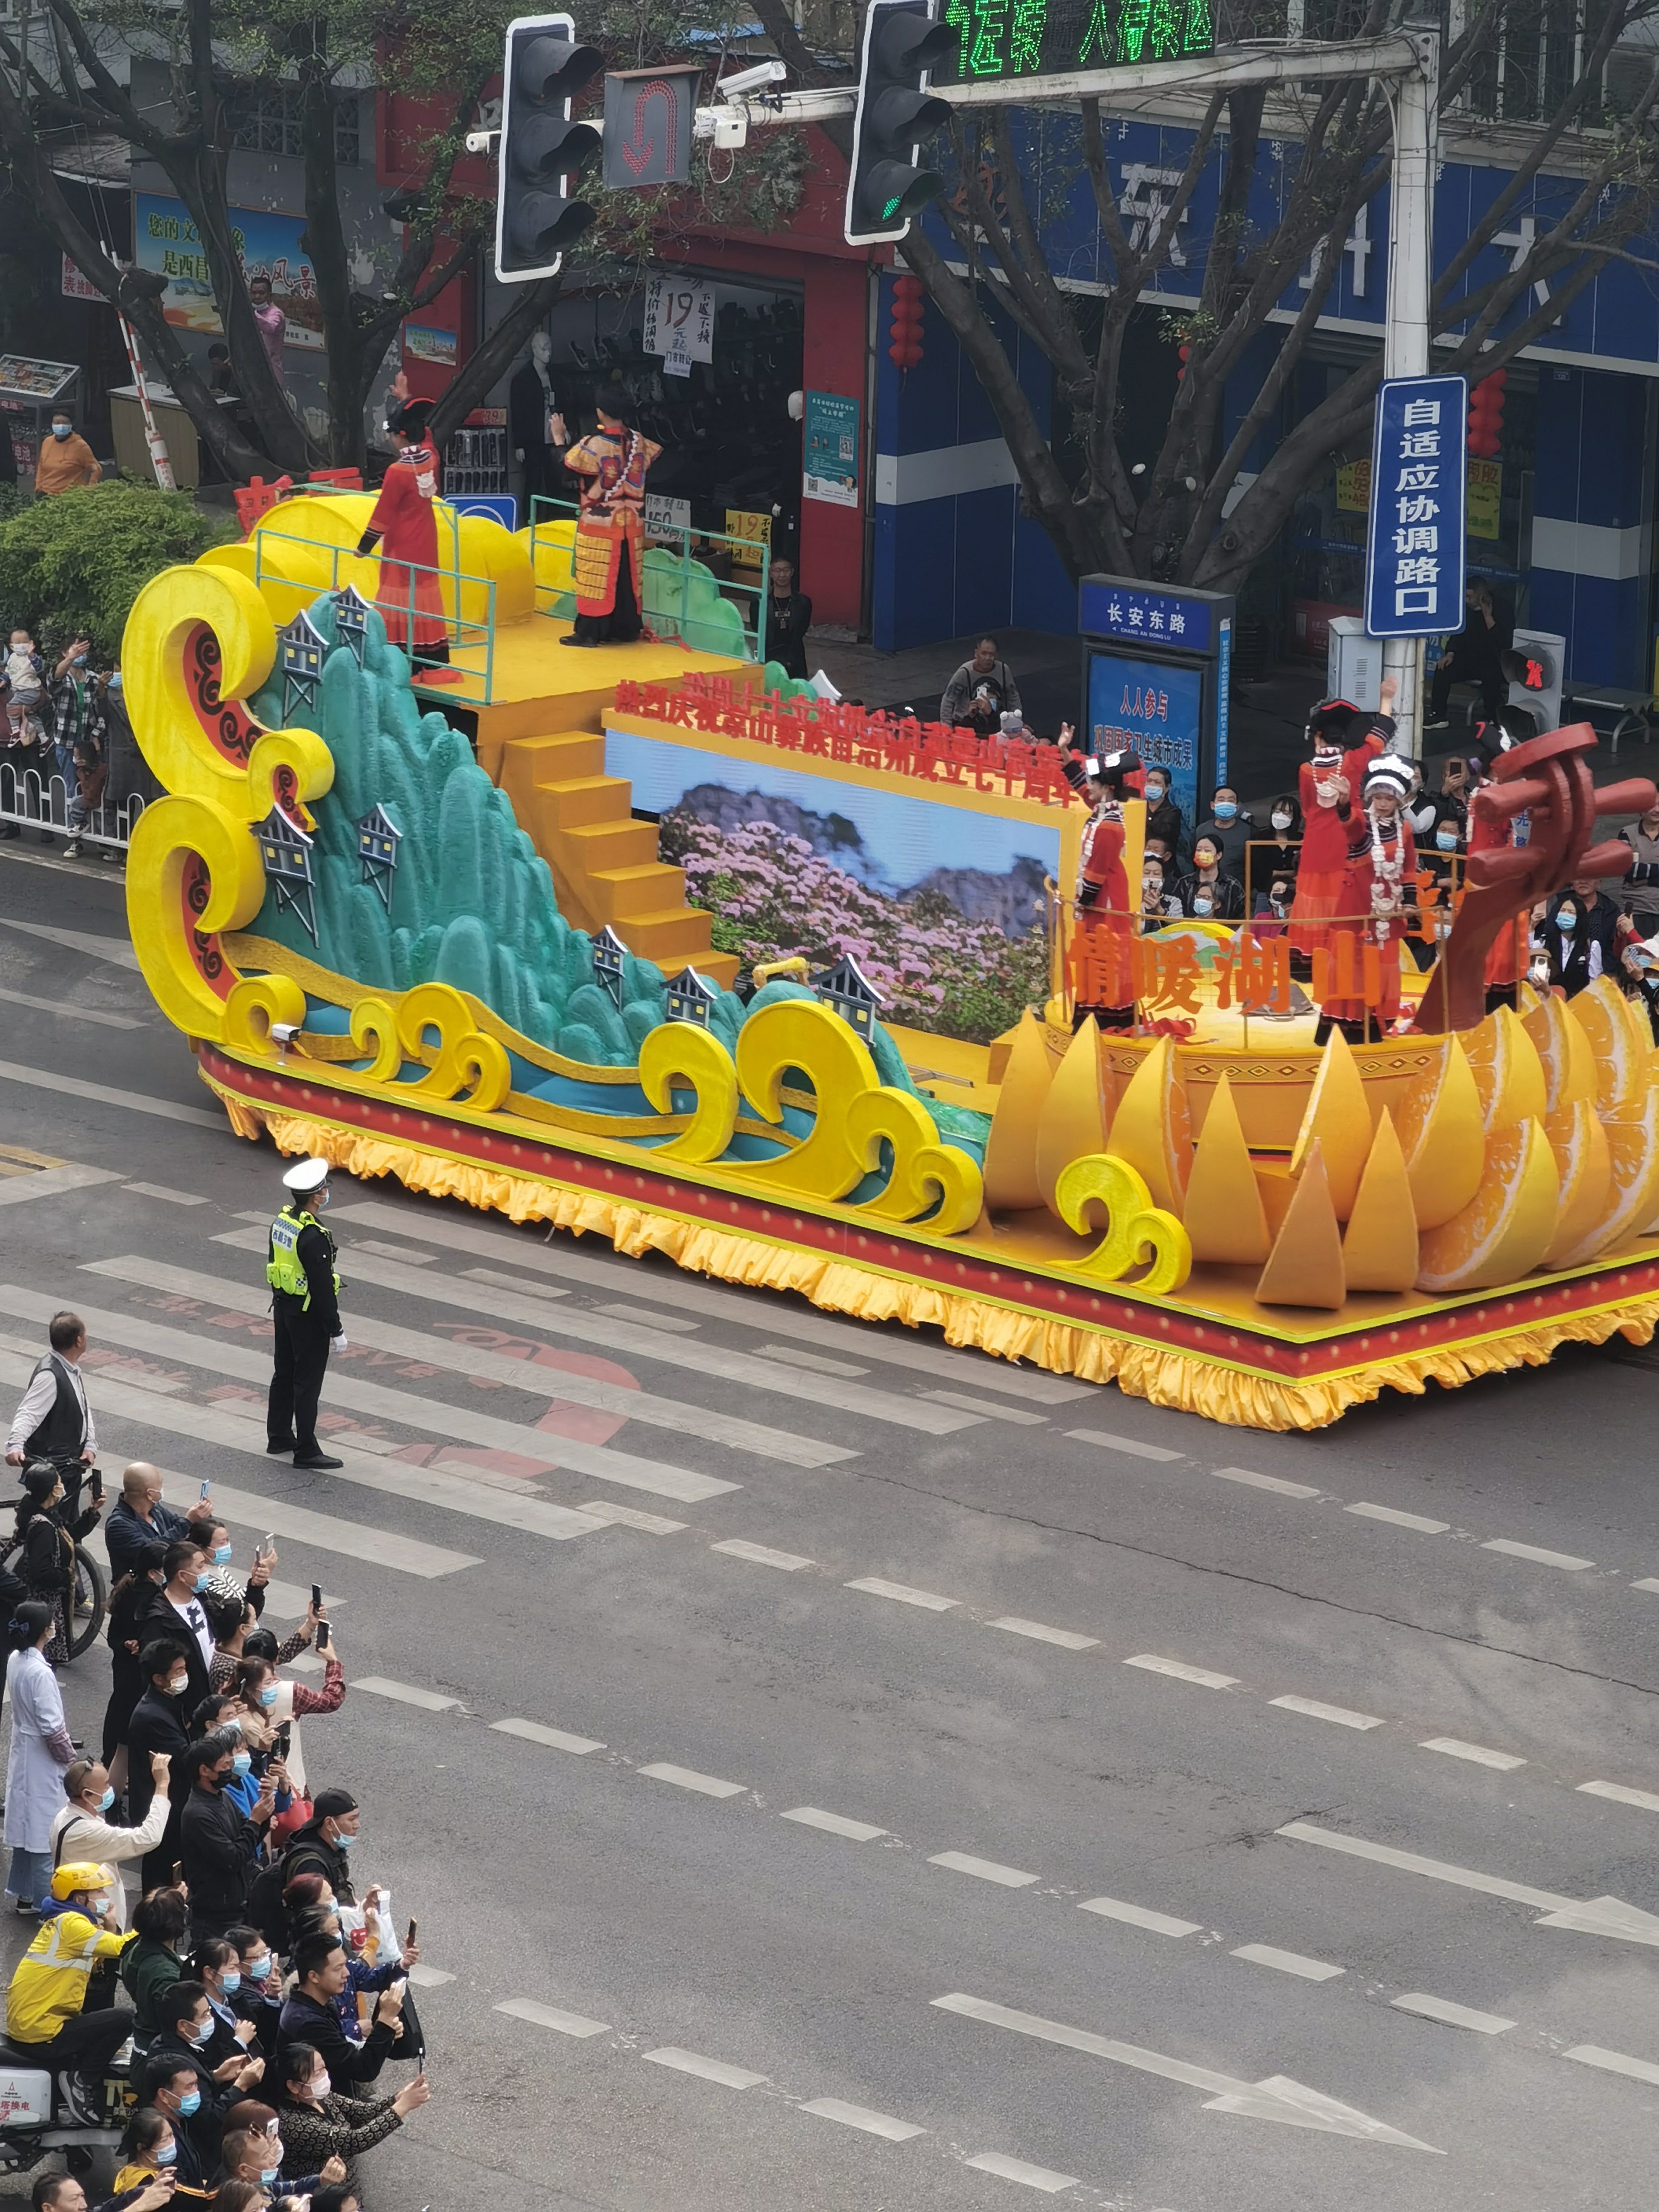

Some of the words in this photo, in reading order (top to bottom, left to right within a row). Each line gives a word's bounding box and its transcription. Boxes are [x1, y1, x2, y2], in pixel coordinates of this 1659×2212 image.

[665, 292, 694, 329] 19
[736, 514, 759, 537] 19
[1392, 398, 1441, 617] 自适应协调路口
[1107, 603, 1186, 635] 长安东路
[1120, 627, 1139, 635] CHANG
[1120, 685, 1168, 723] 人人参与
[615, 679, 1079, 809] 热烈庆祝凉山彝族自治州成立七十周年
[1093, 724, 1193, 771] 巩固国家卫生城市成果
[1069, 920, 1380, 1015] 情暖湖山
